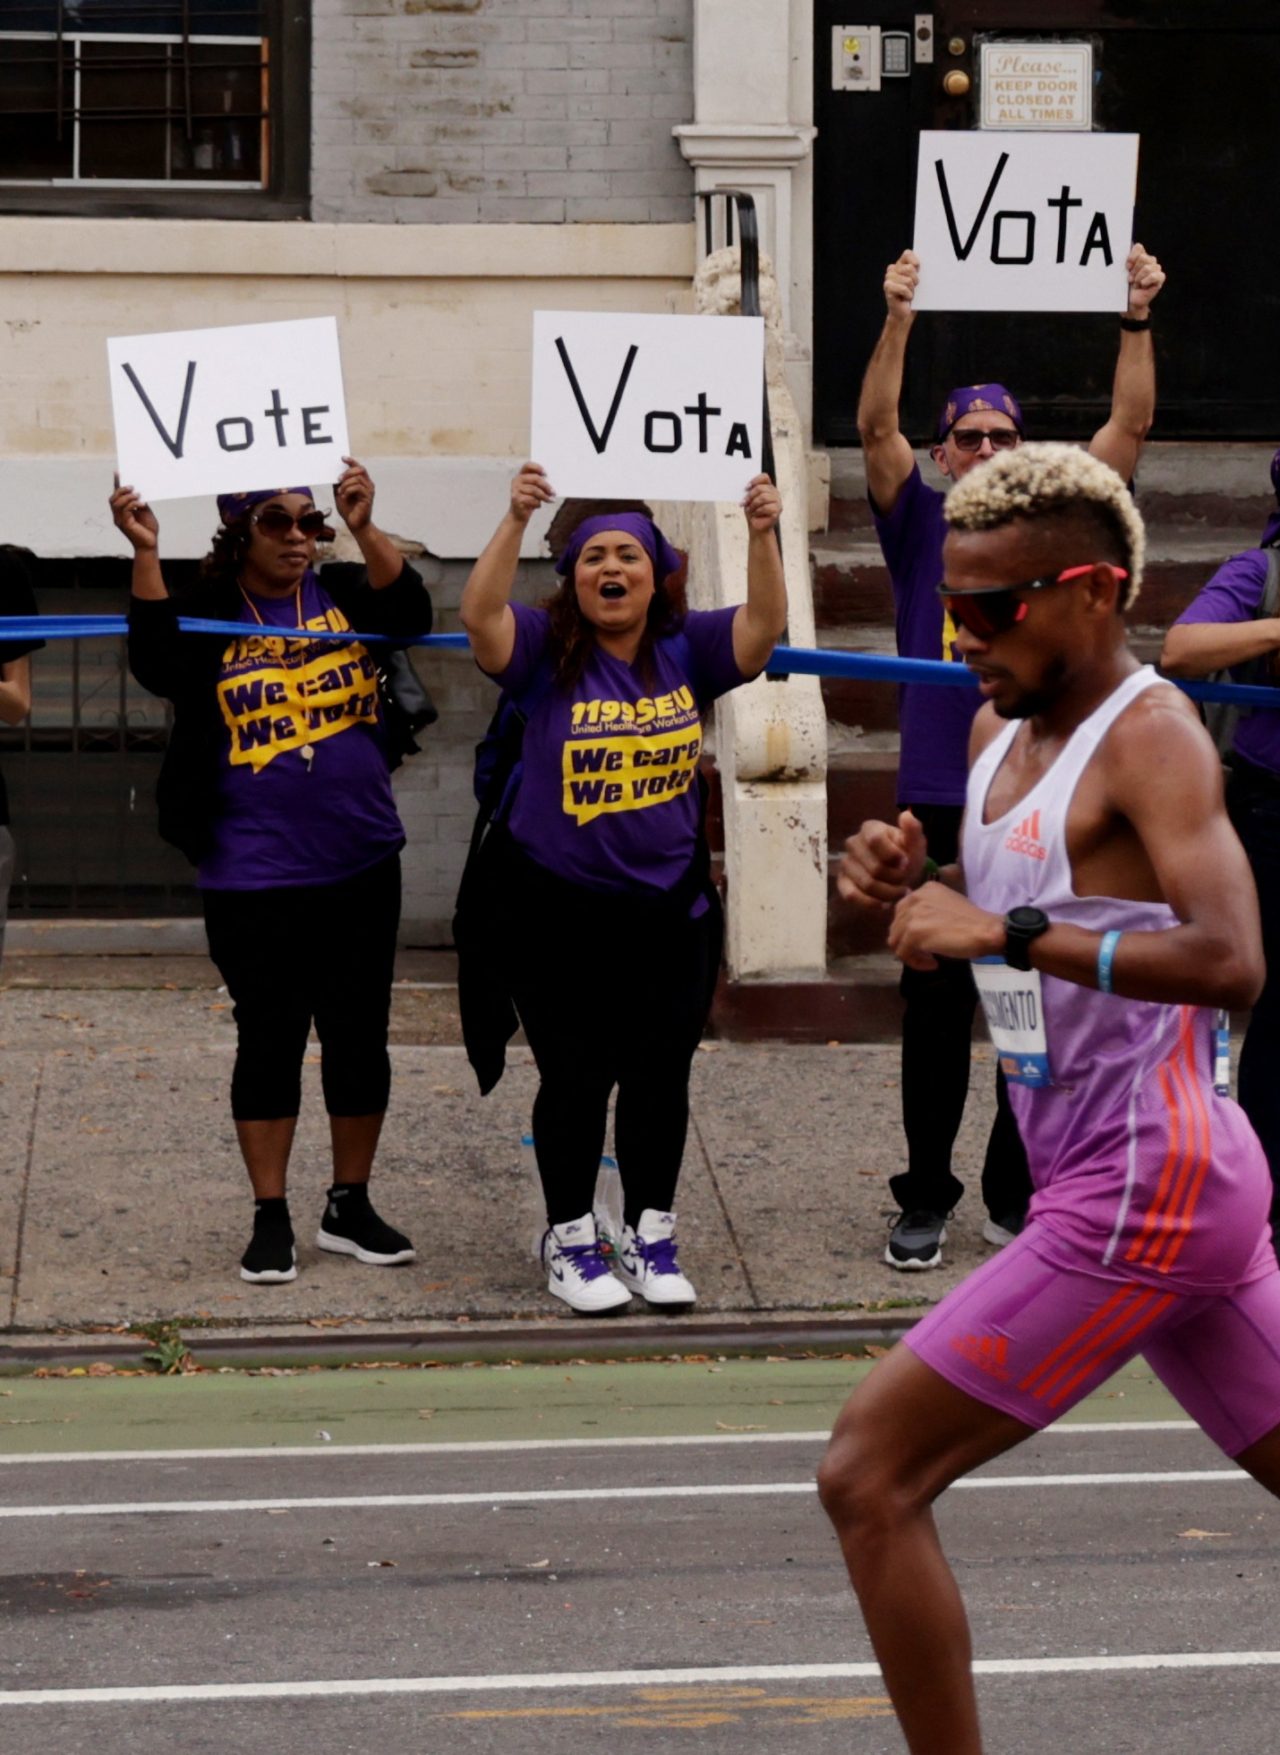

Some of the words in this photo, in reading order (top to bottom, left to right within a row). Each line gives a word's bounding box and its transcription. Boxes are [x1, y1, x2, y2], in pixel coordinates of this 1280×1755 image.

[994, 81, 1032, 92] KEEP
[1037, 81, 1078, 92] DOOR
[996, 94, 1053, 105] CLOSED
[1058, 95, 1076, 105] AT
[998, 109, 1025, 119] ALL
[1030, 109, 1074, 120] TIMES
[223, 679, 289, 717] We
[296, 655, 375, 696] care
[238, 716, 297, 751] We
[571, 722, 602, 735] United
[571, 747, 623, 774] We
[632, 738, 699, 768] care
[569, 778, 623, 806] We
[631, 767, 691, 800] vote
